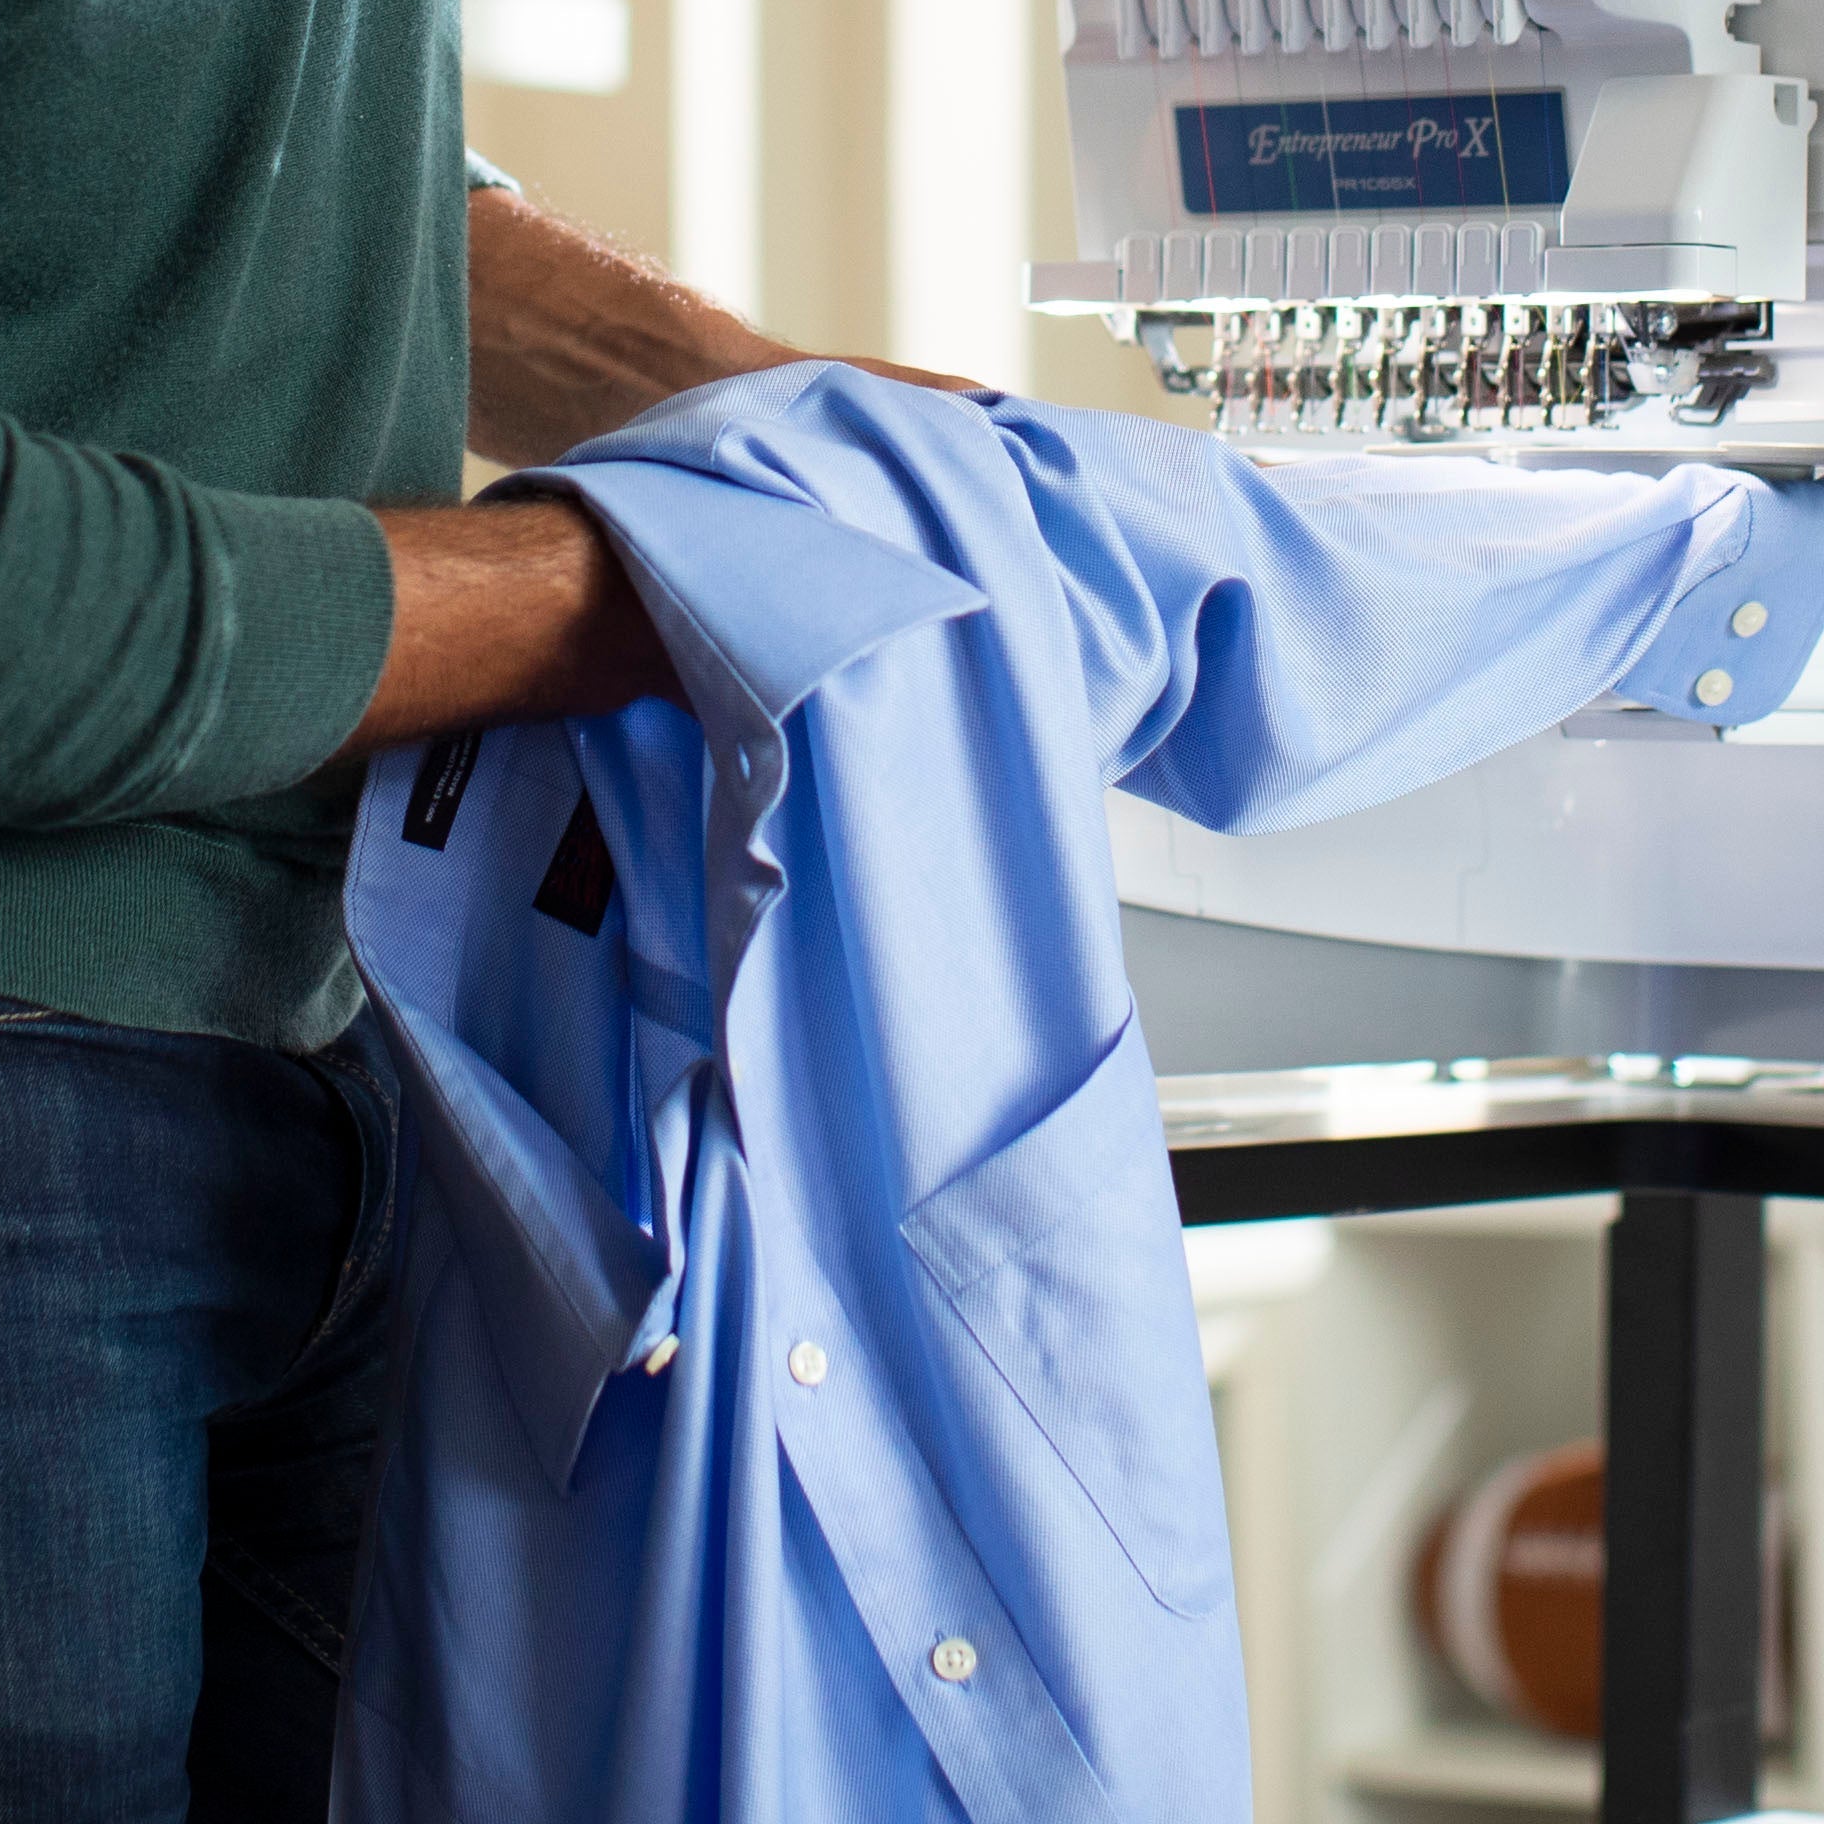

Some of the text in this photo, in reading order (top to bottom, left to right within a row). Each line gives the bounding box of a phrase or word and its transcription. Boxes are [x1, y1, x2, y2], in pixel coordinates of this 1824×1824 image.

[1247, 116, 1494, 167] Entrepreneur Pro X
